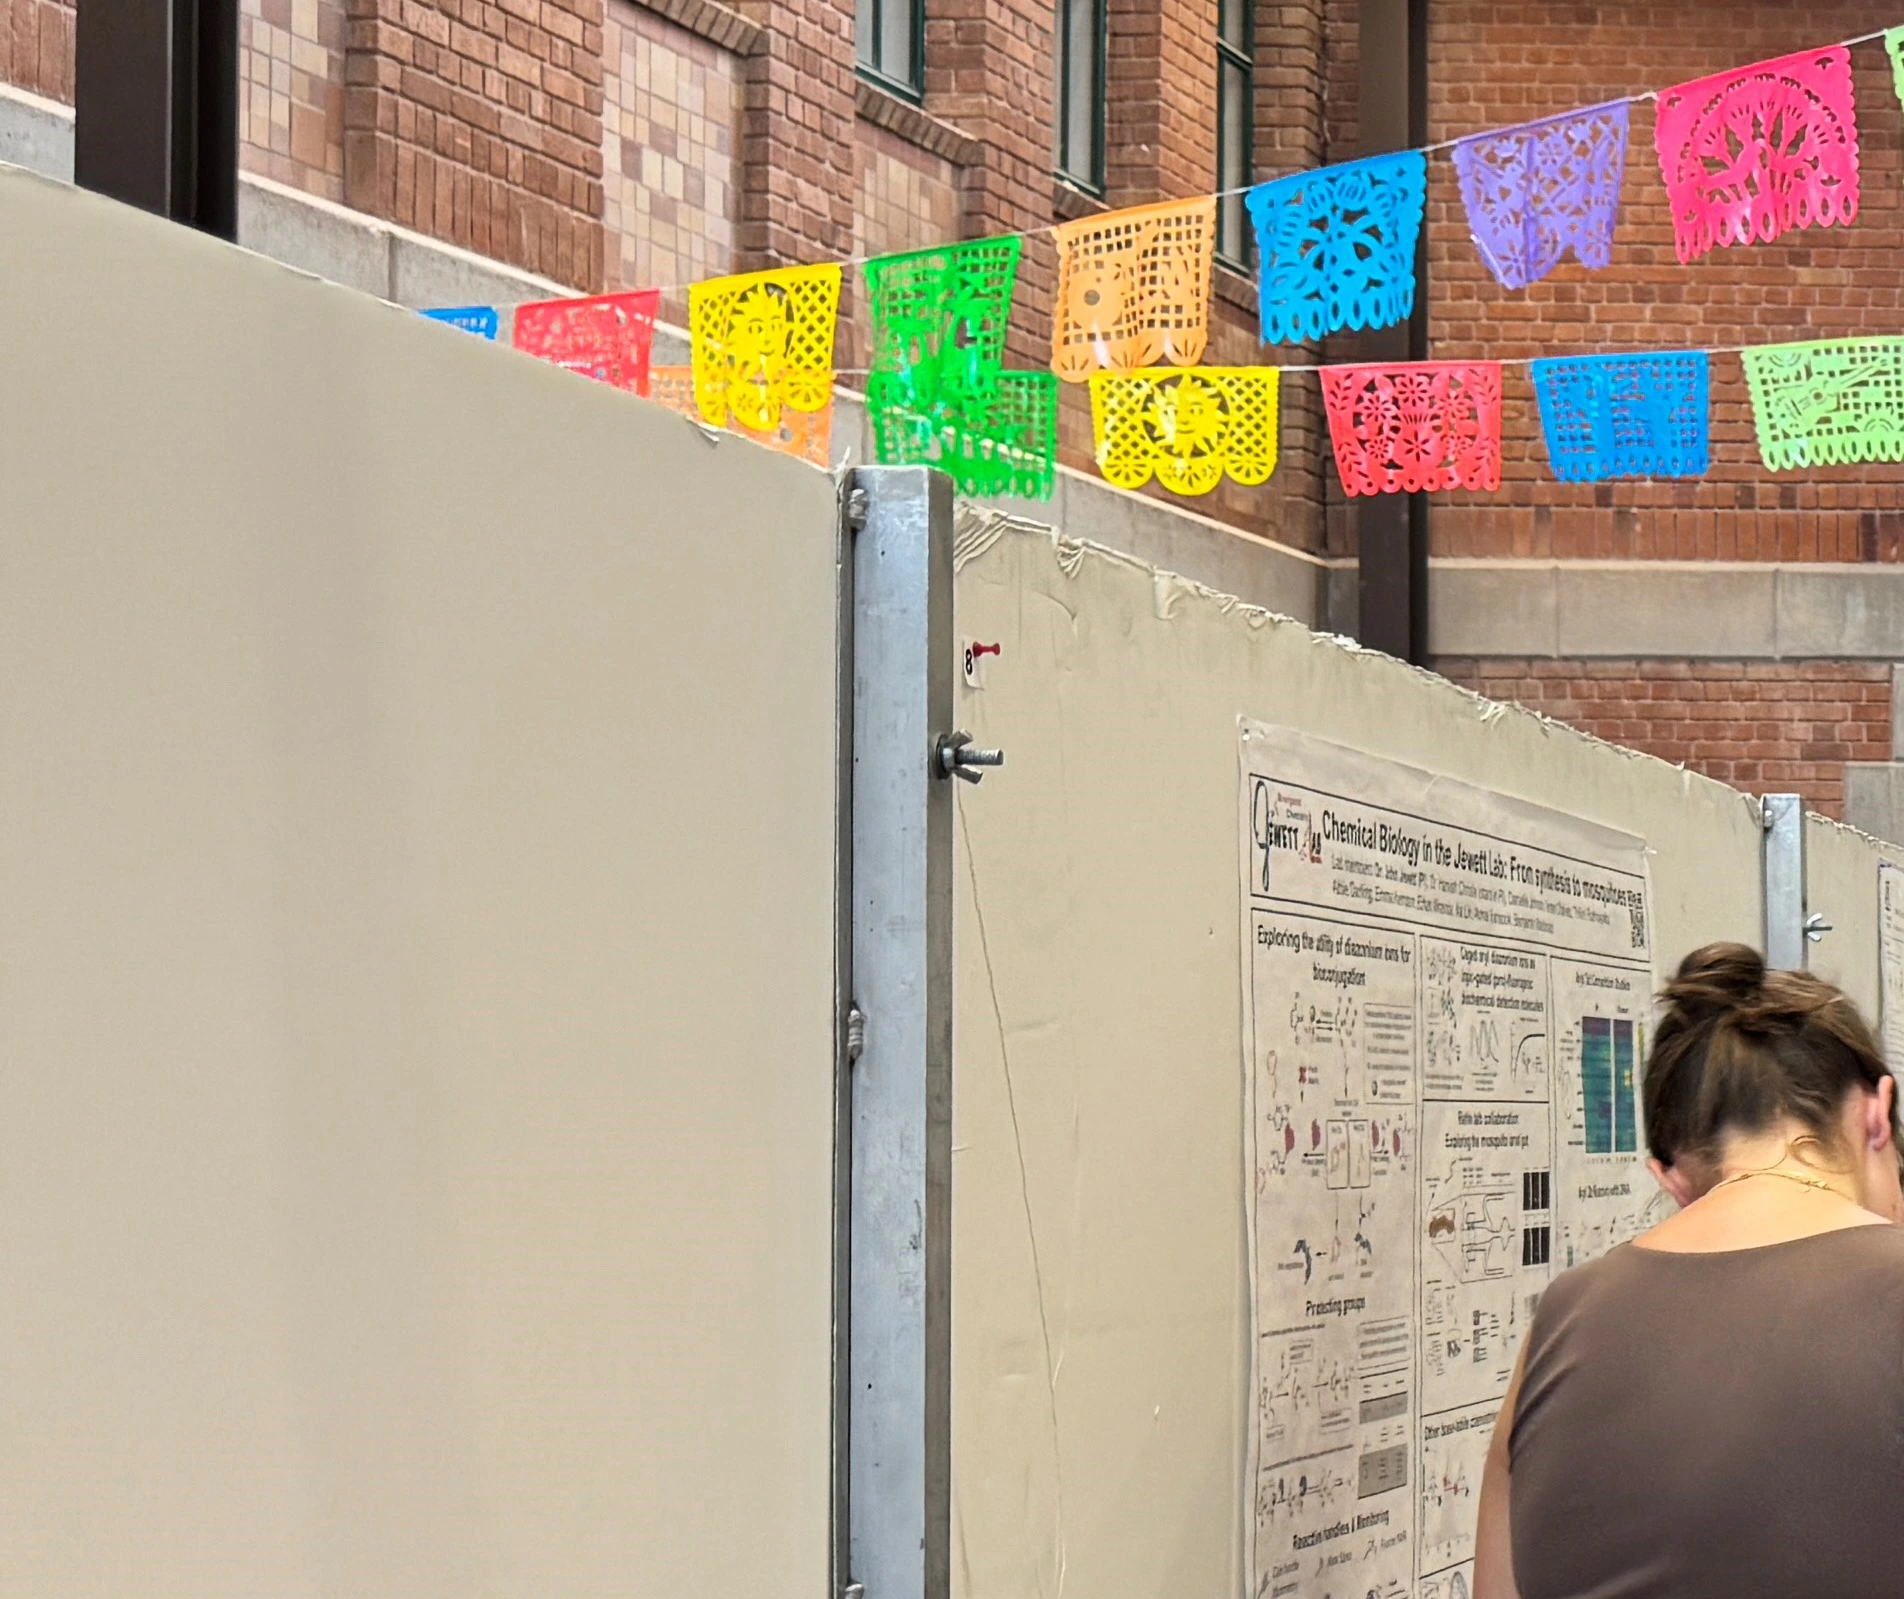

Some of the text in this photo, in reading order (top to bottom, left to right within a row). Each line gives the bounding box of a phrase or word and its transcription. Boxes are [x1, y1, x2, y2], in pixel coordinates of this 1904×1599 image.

[965, 648, 973, 675] 8
[1322, 809, 1377, 850] Chemical
[1379, 823, 1420, 867] Biology
[1422, 834, 1433, 862] in
[1435, 838, 1452, 867] the
[1454, 841, 1488, 875] Jewett
[1489, 849, 1507, 880] Lab:
[1510, 855, 1534, 884] From
[1535, 866, 1571, 895] synthesis
[1572, 874, 1582, 897] to
[1257, 924, 1300, 954] Exploring
[1301, 931, 1314, 950] the
[1335, 934, 1343, 955] of
[1400, 945, 1412, 964] for
[1306, 1298, 1342, 1317] Protecting
